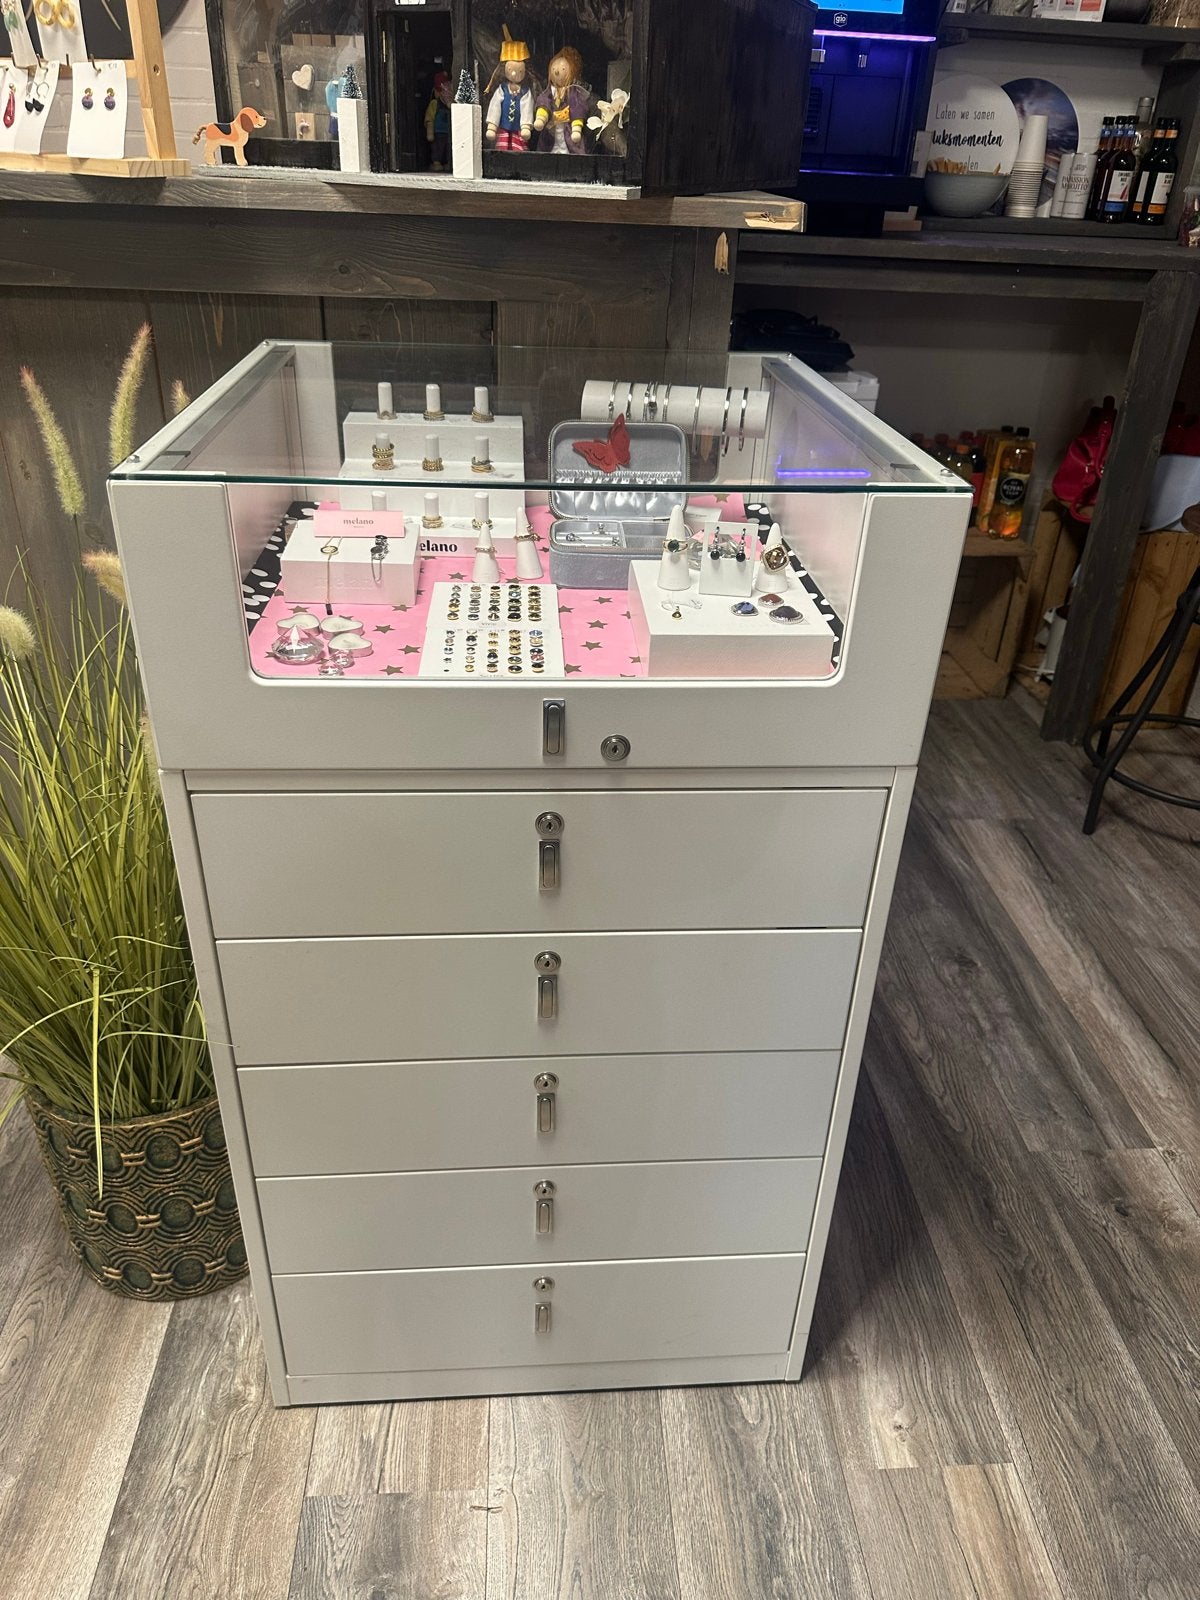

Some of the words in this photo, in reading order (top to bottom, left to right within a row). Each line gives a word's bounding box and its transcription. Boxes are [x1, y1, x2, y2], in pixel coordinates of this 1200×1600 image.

[835, 14, 847, 24] gio
[936, 103, 957, 119] Laten
[961, 110, 971, 120] we
[974, 110, 995, 119] samen
[932, 129, 1004, 147] luksmomenten
[343, 517, 374, 525] melano
[419, 540, 458, 553] elano
